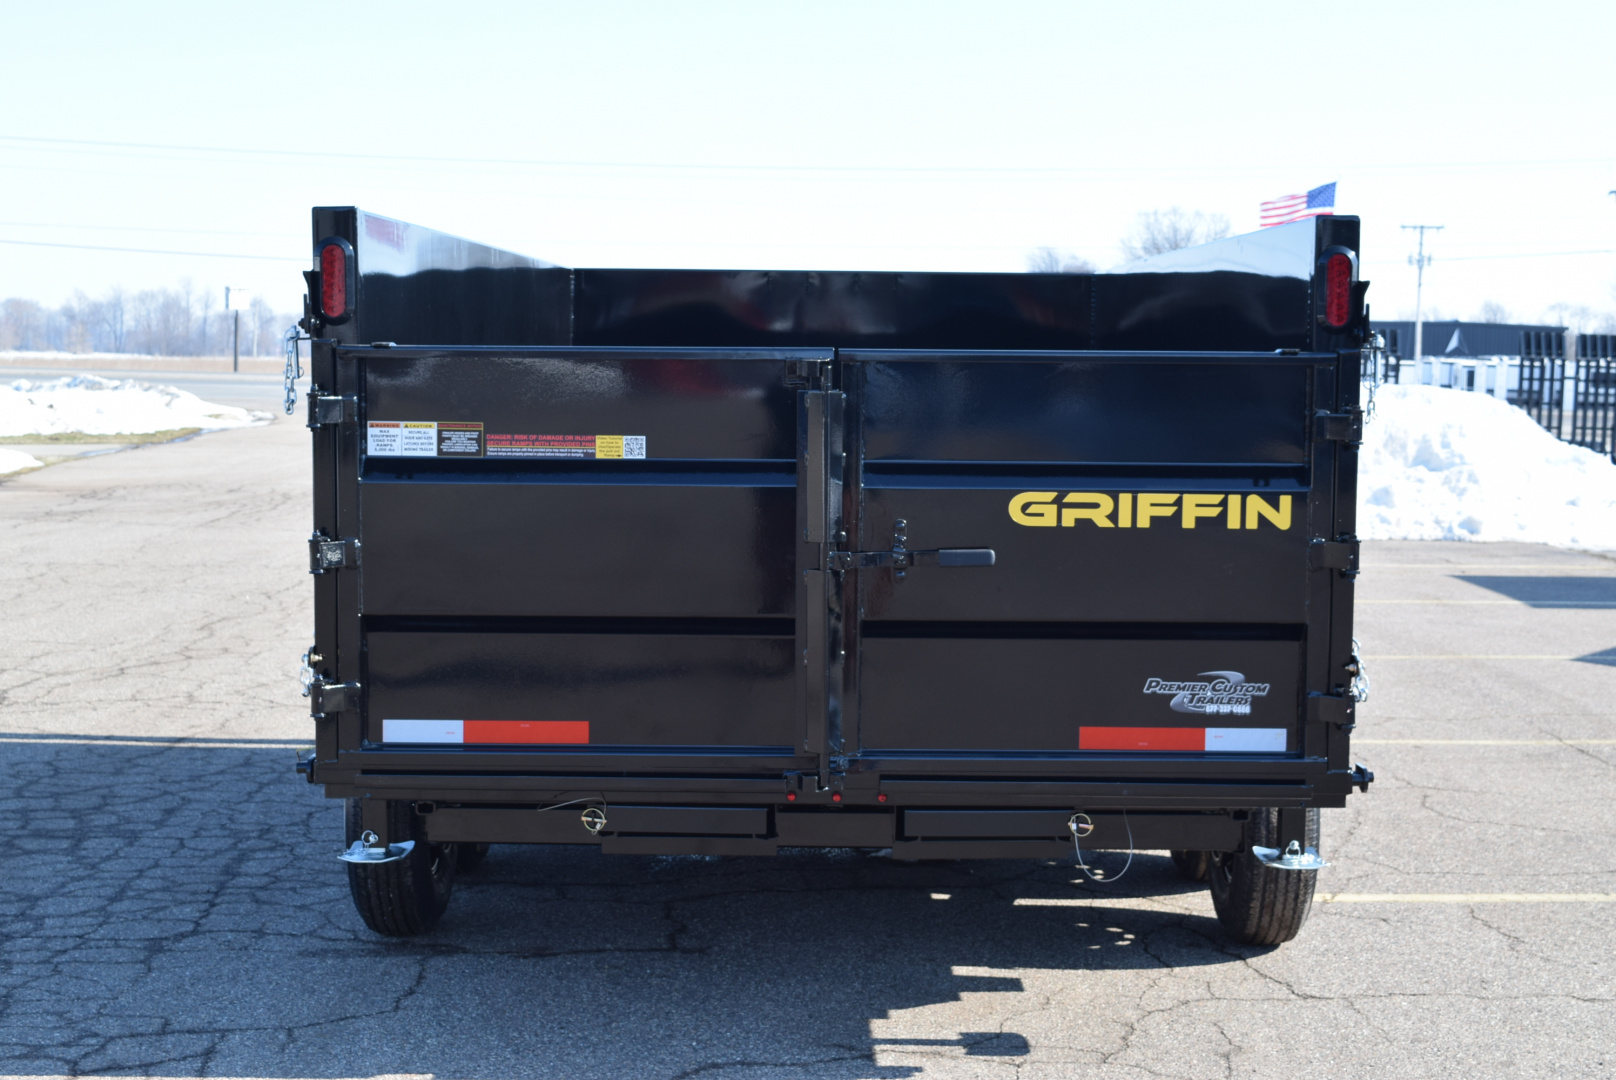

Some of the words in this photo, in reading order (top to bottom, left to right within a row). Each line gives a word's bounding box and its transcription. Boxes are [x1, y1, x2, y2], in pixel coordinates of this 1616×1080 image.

[1008, 491, 1292, 530] GRIFFIN
[1143, 678, 1209, 693] PREMIER
[1210, 679, 1270, 696] CUSTOM
[1187, 694, 1251, 706] TRAILERS
